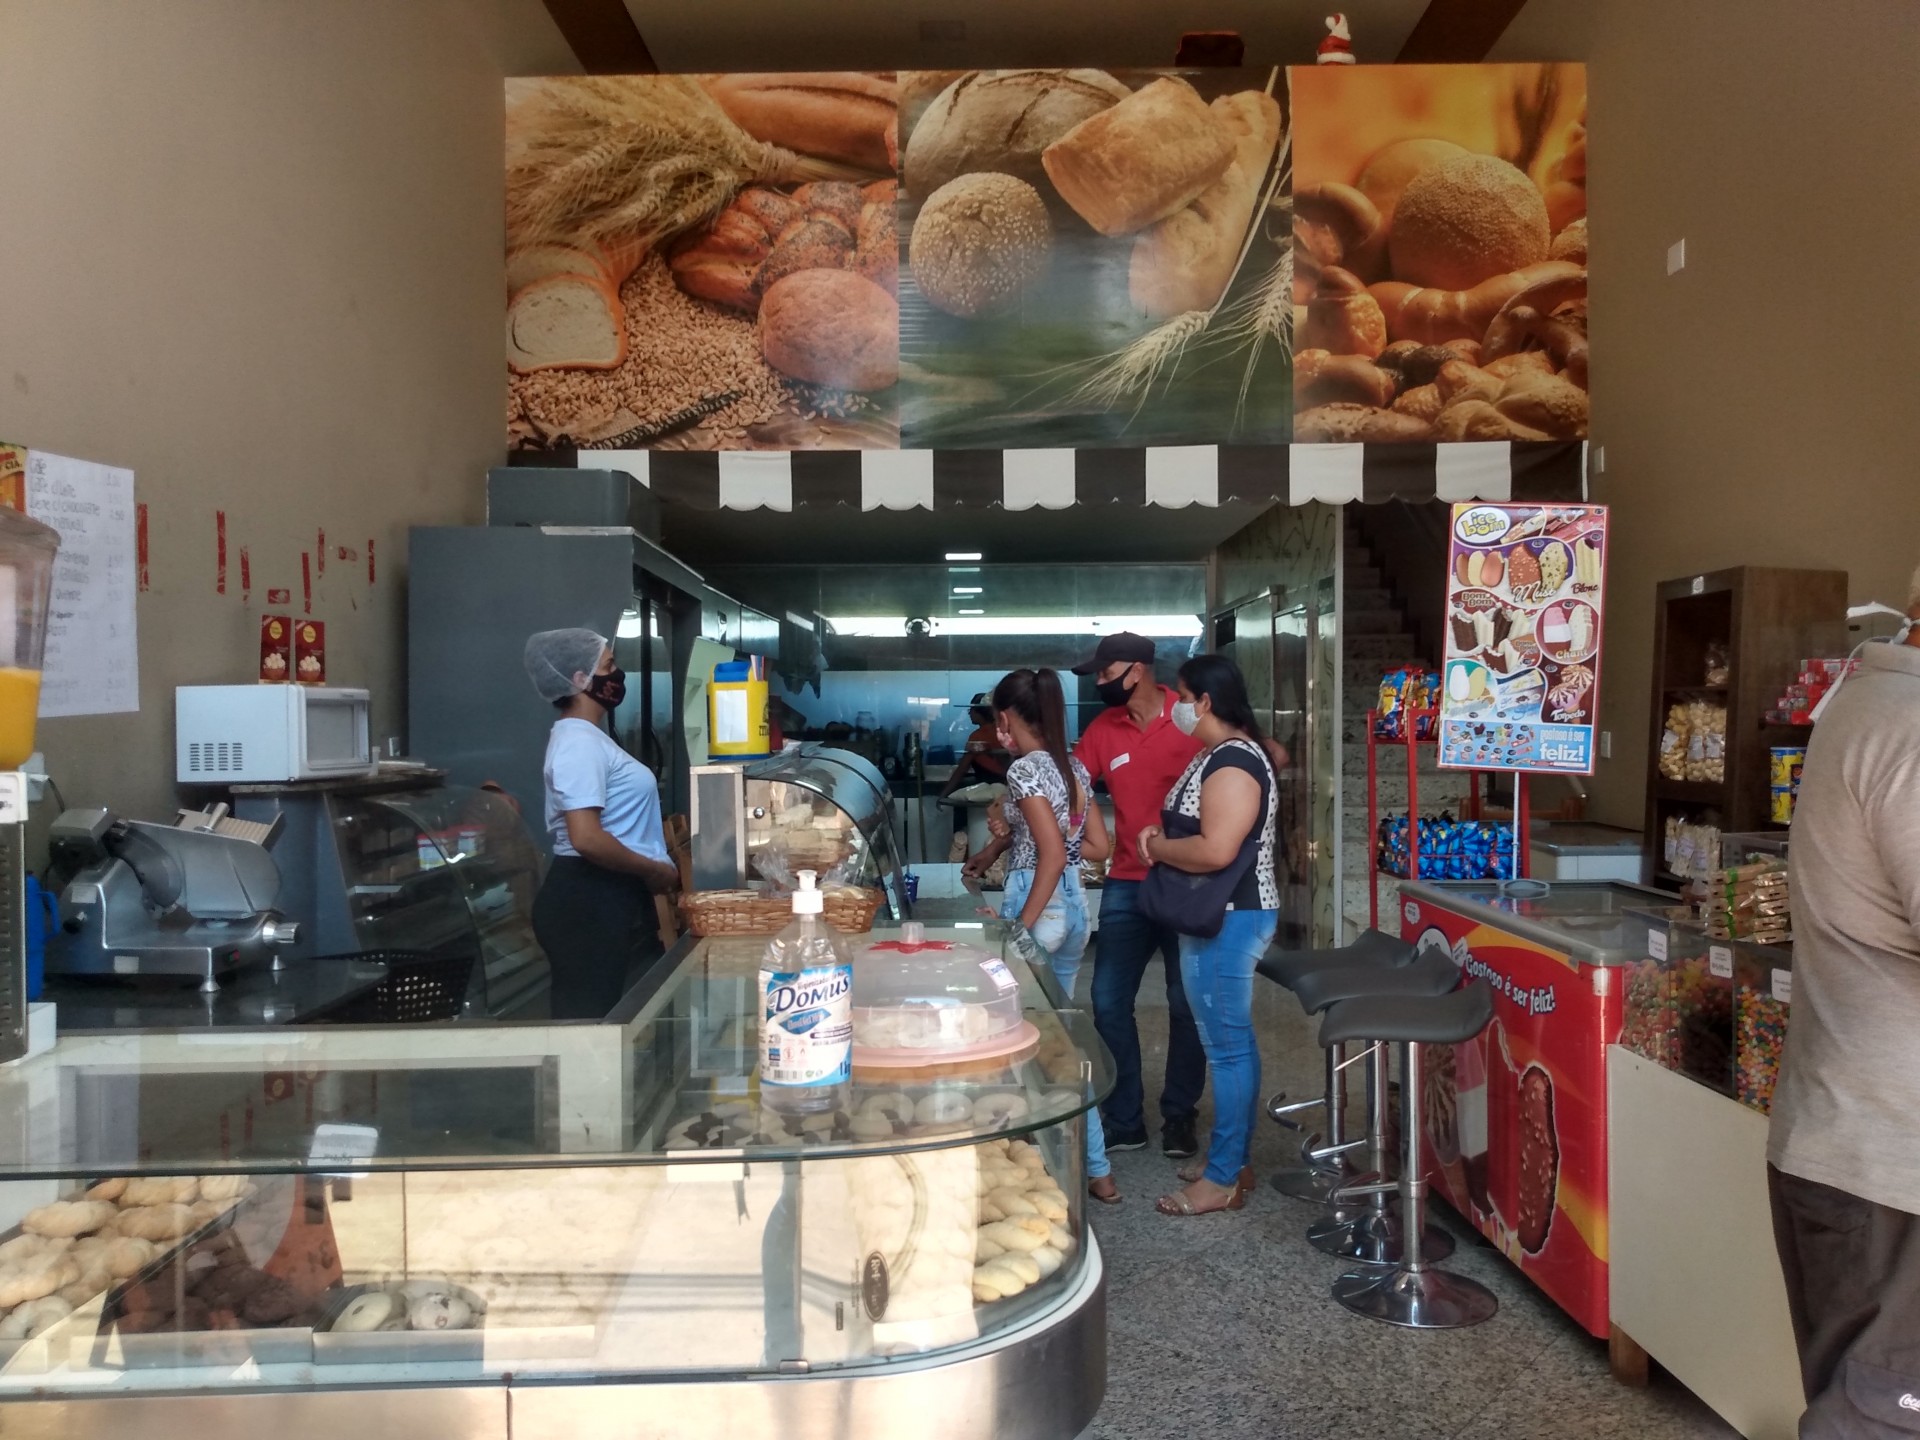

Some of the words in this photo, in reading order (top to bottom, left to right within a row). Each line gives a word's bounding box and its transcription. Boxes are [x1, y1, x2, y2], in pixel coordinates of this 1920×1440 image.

[1471, 511, 1497, 525] ice
[1461, 519, 1507, 537] bom
[1550, 708, 1587, 722] Torpedo
[1540, 743, 1585, 762] feliz!
[1505, 976, 1511, 996] é
[1512, 986, 1528, 1008] ser
[1530, 985, 1556, 1016] feliz!
